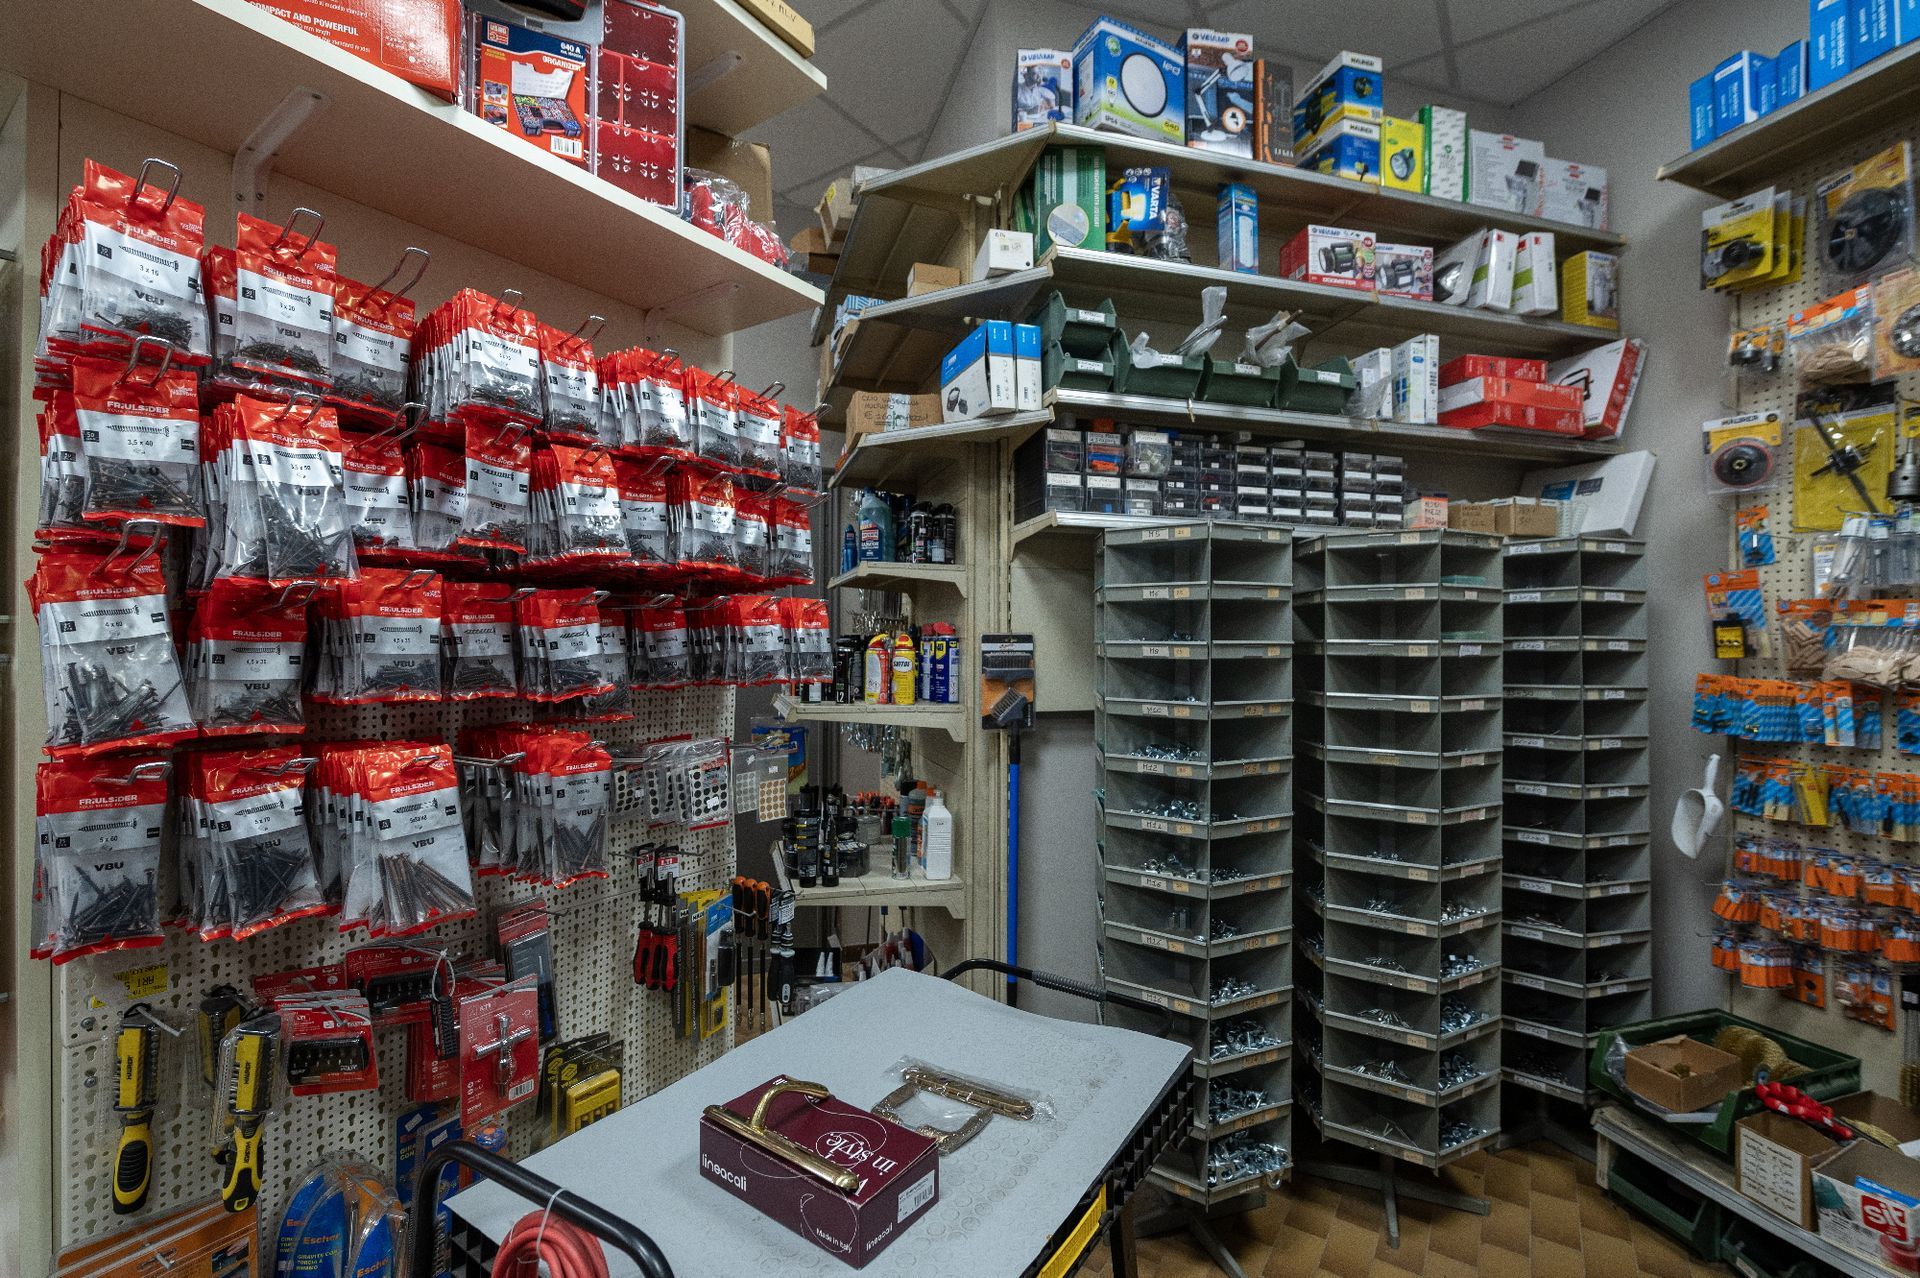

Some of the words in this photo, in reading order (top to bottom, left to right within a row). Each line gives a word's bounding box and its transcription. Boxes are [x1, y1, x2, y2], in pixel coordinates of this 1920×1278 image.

[293, 12, 312, 24] AND
[313, 17, 359, 36] POWERFUL
[1148, 187, 1161, 220] VARTA
[134, 289, 165, 306] VBU
[275, 327, 301, 339] VBU
[106, 644, 136, 656] VBU
[393, 660, 415, 668] VBU
[244, 682, 271, 690] VBU
[576, 808, 593, 817] VBU
[259, 838, 282, 850] VBU
[412, 837, 435, 848] VBU
[94, 862, 124, 872] VBU
[702, 1153, 747, 1193] lineacali
[816, 1227, 832, 1244] Made
[840, 1239, 853, 1254] Italy
[866, 1222, 894, 1252] lineacali
